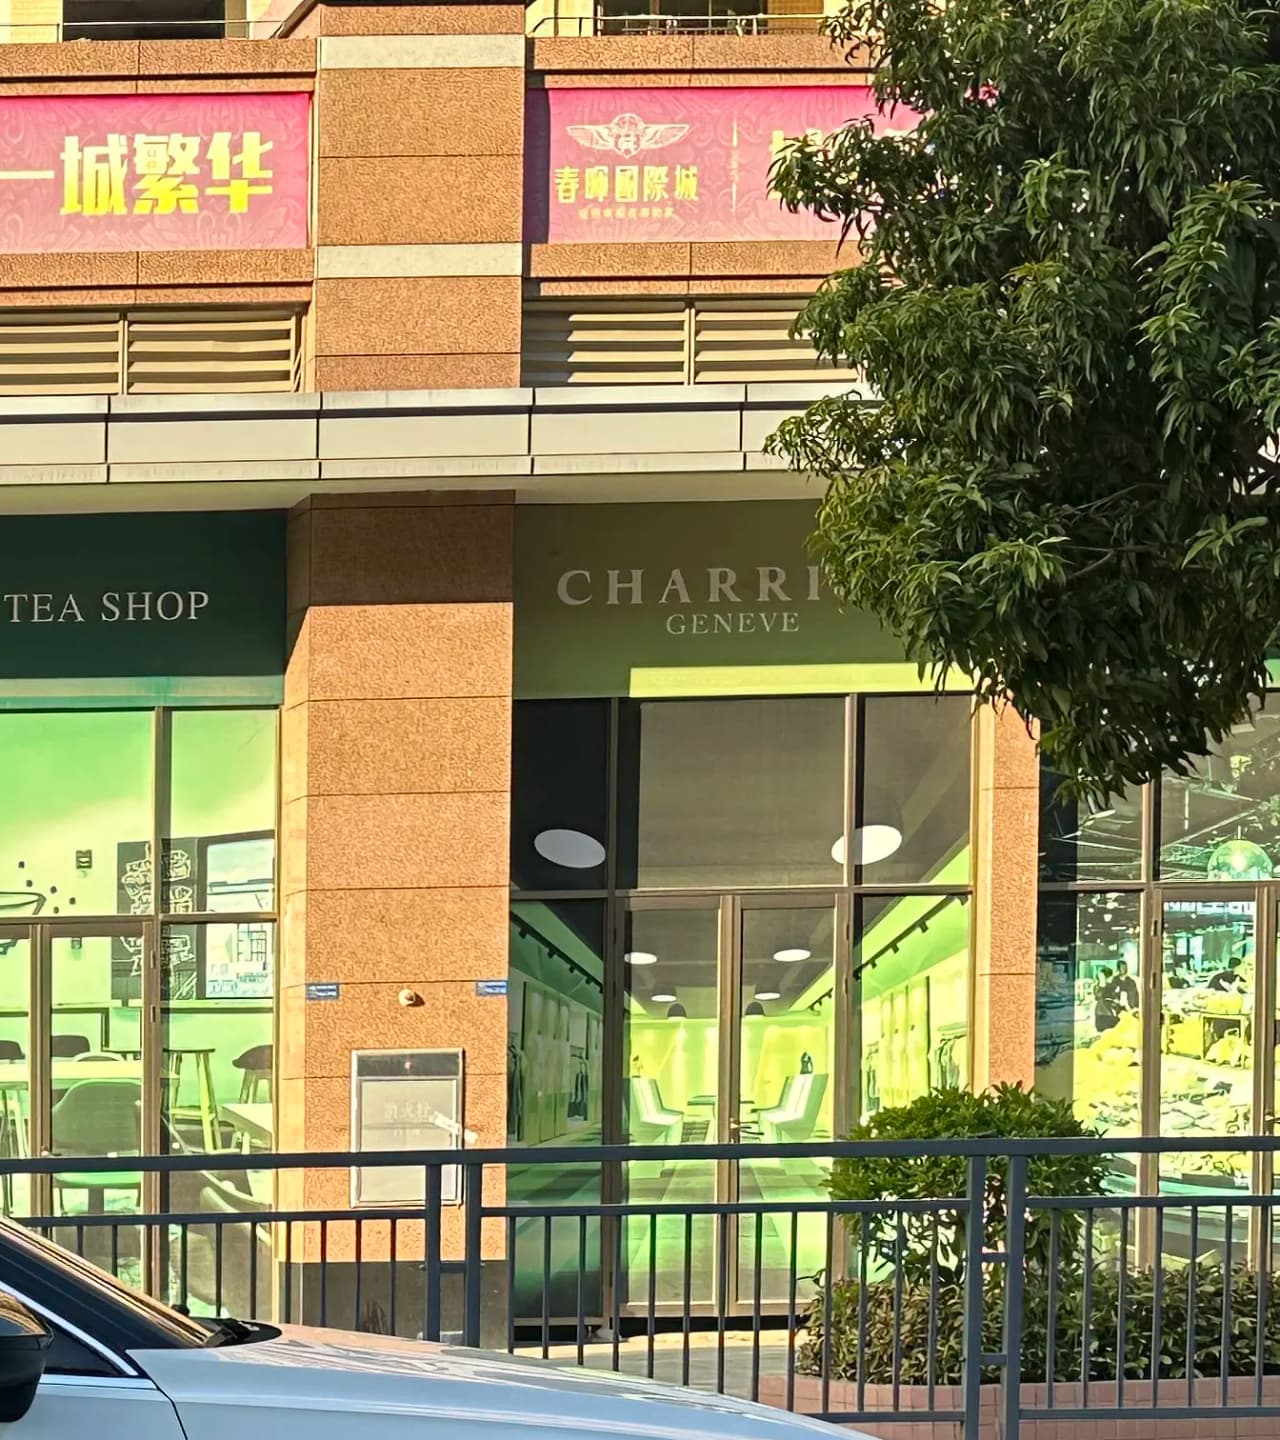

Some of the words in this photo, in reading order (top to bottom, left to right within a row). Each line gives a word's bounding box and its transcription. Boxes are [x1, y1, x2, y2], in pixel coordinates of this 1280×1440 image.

[556, 565, 821, 606] CHARRI
[3, 593, 86, 624] TEA
[100, 590, 209, 622] SHOP
[665, 611, 800, 635] GENEVE
